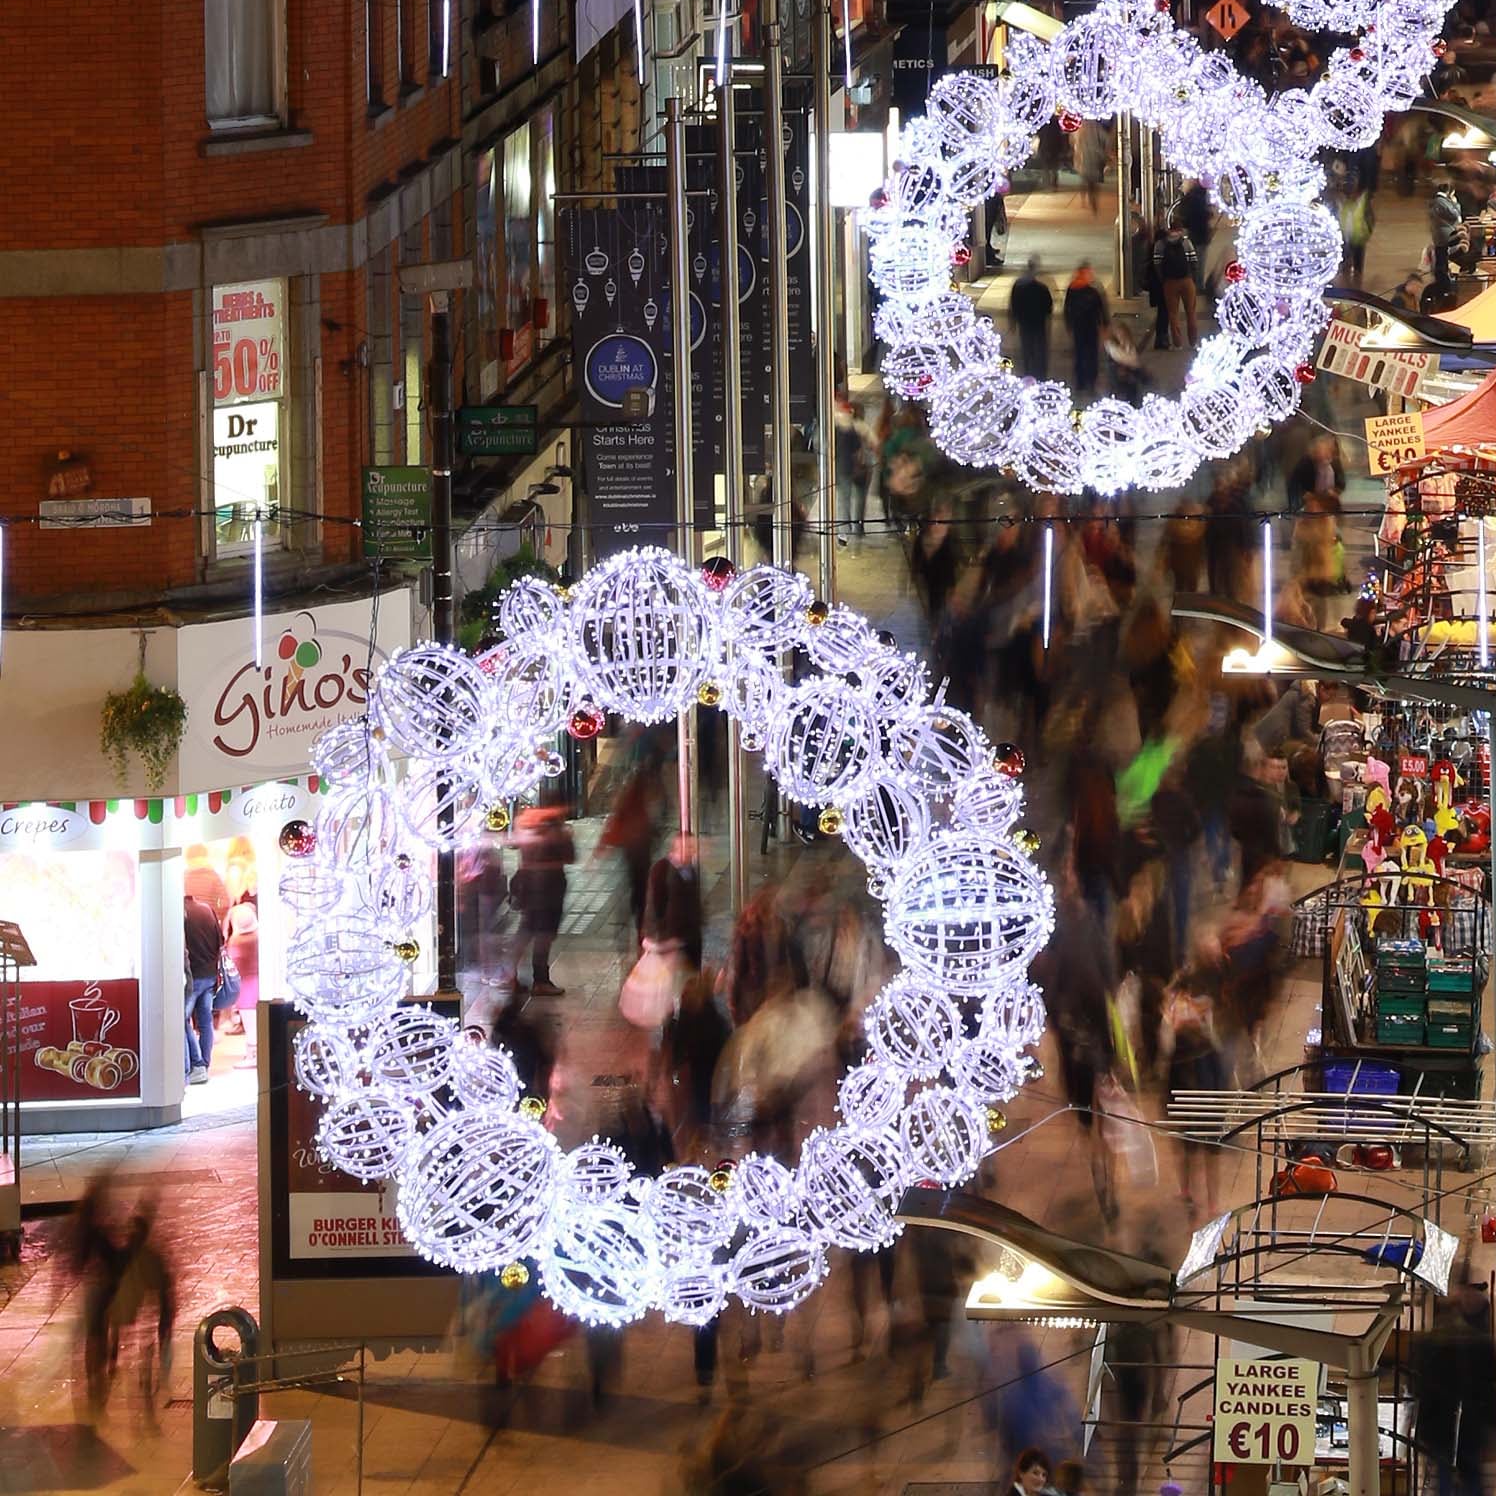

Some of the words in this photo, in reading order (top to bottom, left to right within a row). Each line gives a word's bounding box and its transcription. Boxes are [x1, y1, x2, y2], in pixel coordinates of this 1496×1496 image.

[969, 68, 994, 78] USH
[222, 292, 254, 308] HERBS
[214, 303, 275, 324] TREATMENTS
[598, 364, 630, 374] DUBLIN
[632, 364, 645, 373] AT
[258, 371, 279, 393] OFF
[598, 372, 645, 382] CHRISTMAS
[228, 413, 258, 438] Dr
[1375, 415, 1412, 428] LARGE
[1372, 425, 1416, 438] YANKEE
[592, 434, 626, 446] Starts
[627, 435, 655, 445] Here
[1369, 434, 1421, 449] CANDLES
[213, 438, 278, 459] cupuncture
[1377, 447, 1417, 472] €10
[369, 471, 386, 485] Dr
[367, 482, 428, 496] Acupuncture
[213, 653, 374, 757] Gino's
[267, 716, 333, 740] Homemade
[1402, 758, 1425, 773] £5.00
[1, 817, 70, 845] Crepes
[21, 1022, 46, 1035] our
[313, 1217, 377, 1232] BURGER
[381, 1217, 401, 1230] KI
[308, 1232, 379, 1247] O'CONNELL
[1234, 1364, 1300, 1379] LARGE
[1226, 1382, 1306, 1398] YANKEE
[1219, 1400, 1312, 1417] CANDLES
[1227, 1421, 1300, 1461] €10
